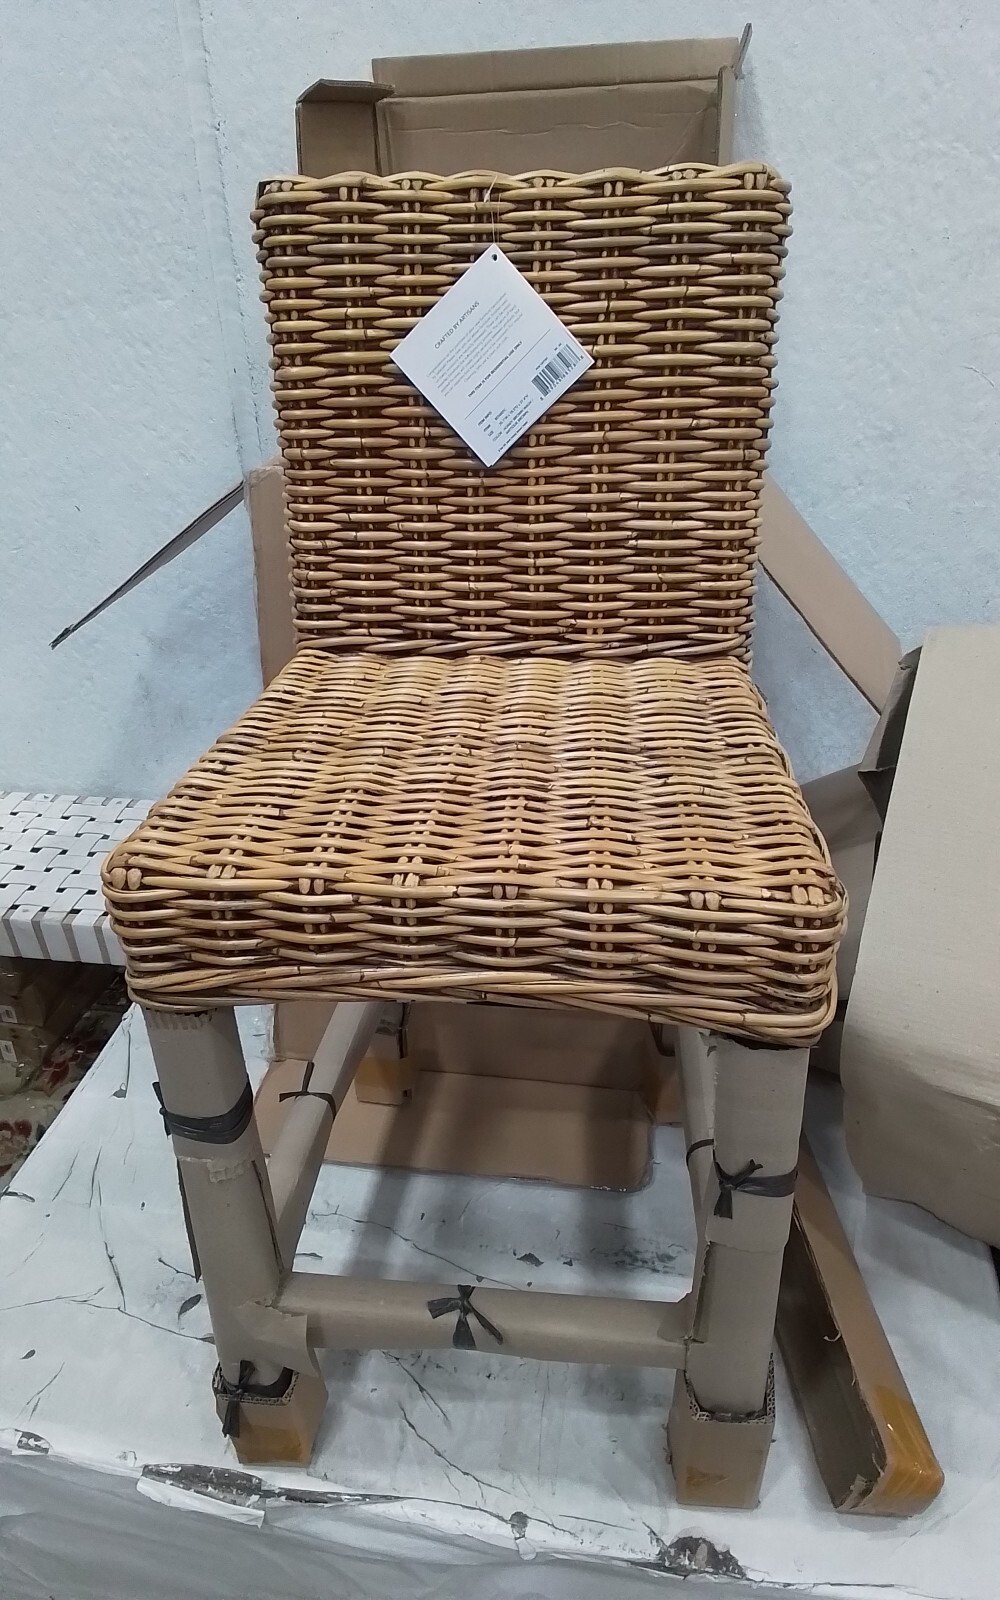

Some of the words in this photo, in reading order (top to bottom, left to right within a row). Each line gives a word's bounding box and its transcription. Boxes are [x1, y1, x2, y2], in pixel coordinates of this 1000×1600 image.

[434, 328, 455, 350] CRAFTED
[458, 300, 480, 324] ARTISANS
[474, 382, 483, 391] ITEM
[490, 355, 509, 375] RESIDENTIAL
[514, 341, 523, 350] ONLY
